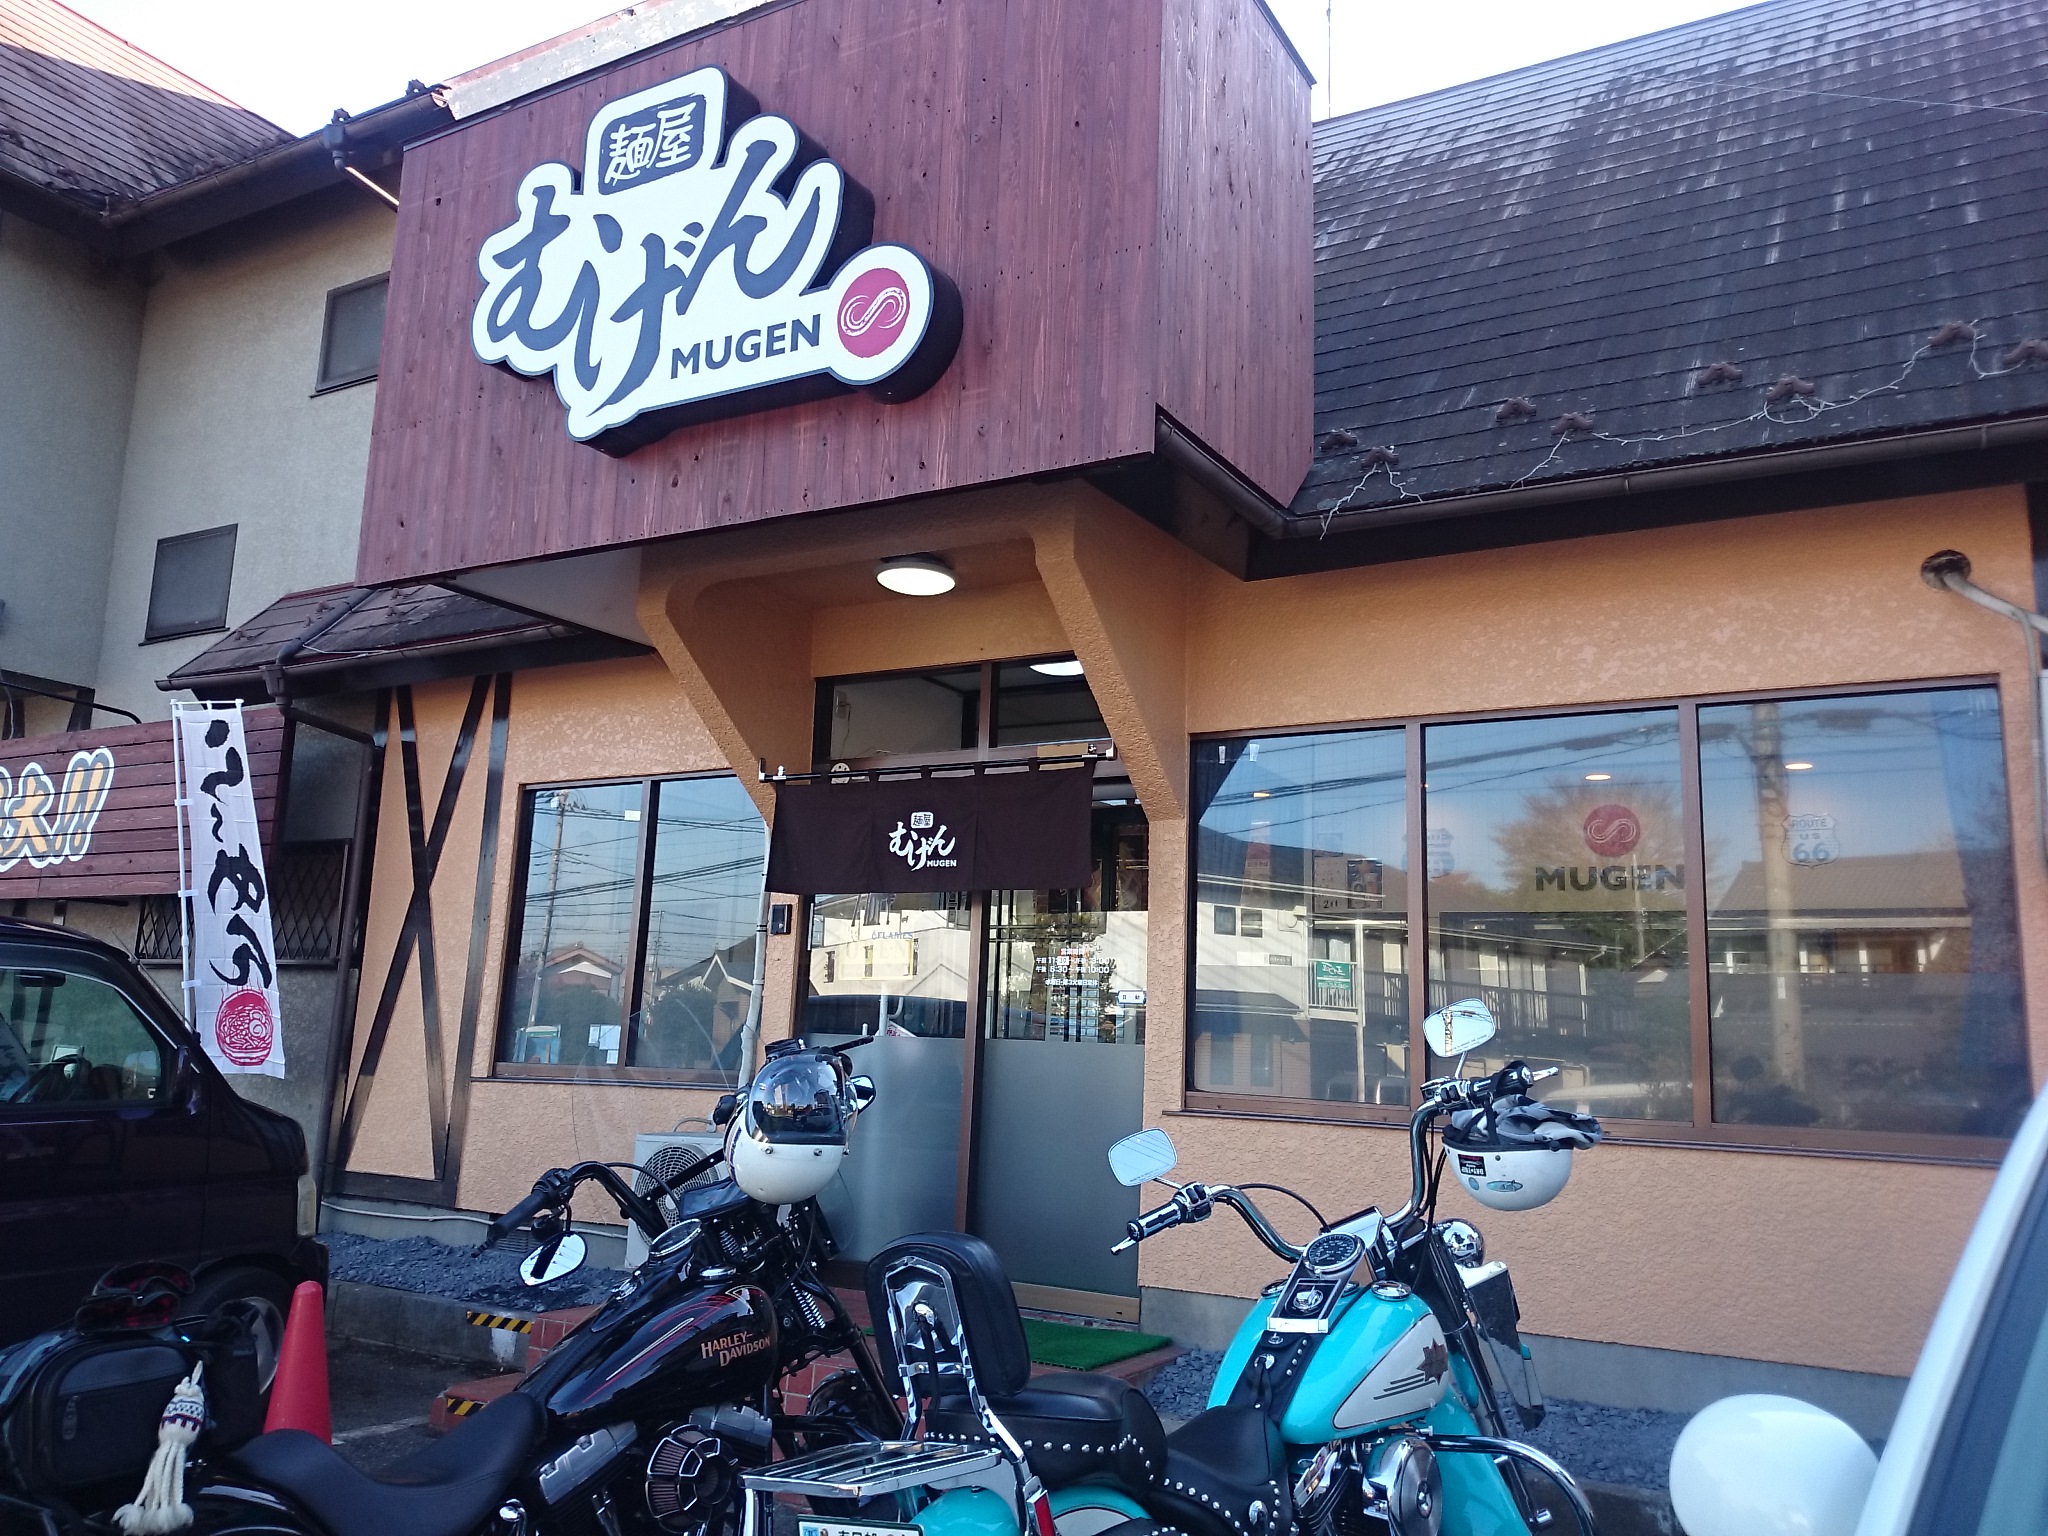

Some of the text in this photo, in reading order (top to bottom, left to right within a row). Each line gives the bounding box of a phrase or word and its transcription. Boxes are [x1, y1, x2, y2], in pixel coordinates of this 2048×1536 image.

[604, 102, 697, 187] 麺屋
[487, 140, 821, 417] むげん
[671, 314, 821, 380] MUGEN
[888, 820, 956, 872] むげん
[926, 859, 957, 868] MUGEN
[1792, 842, 1831, 863] 66
[1535, 864, 1685, 891] MUGEN
[719, 1336, 771, 1367] DAVIDSON
